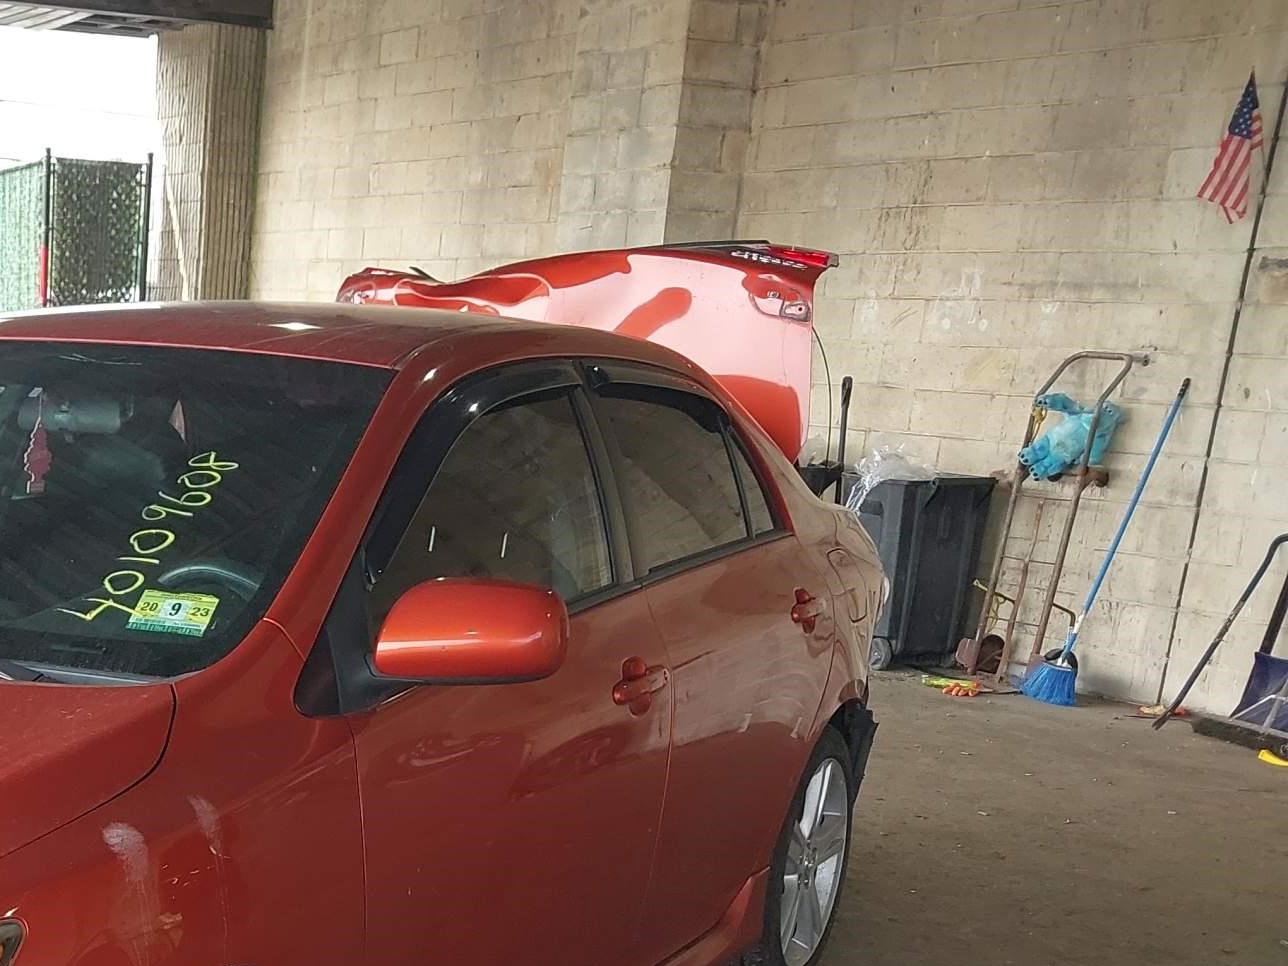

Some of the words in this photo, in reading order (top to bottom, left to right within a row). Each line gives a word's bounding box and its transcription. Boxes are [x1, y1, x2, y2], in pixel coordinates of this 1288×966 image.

[56, 451, 239, 621] 40109608
[140, 601, 159, 612] 20
[169, 602, 183, 617] 9
[189, 607, 210, 618] 23
